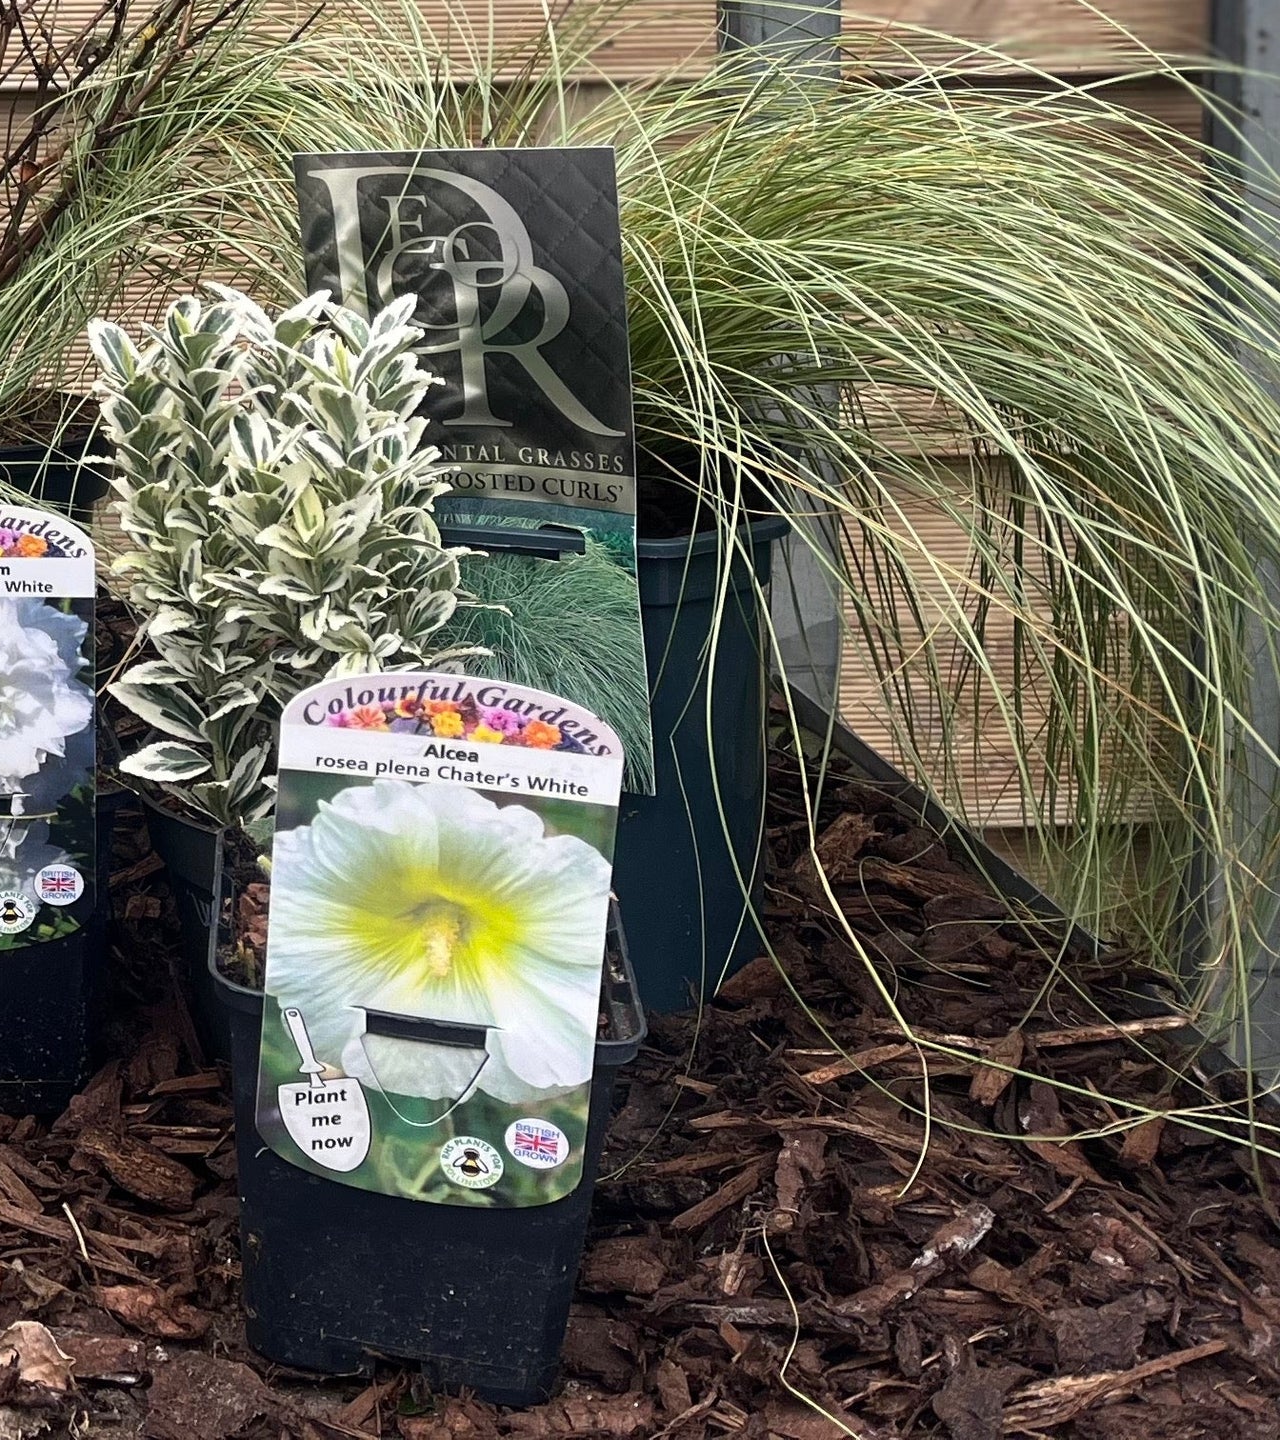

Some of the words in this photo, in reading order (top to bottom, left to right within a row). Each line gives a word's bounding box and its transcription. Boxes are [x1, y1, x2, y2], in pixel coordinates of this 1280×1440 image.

[518, 446, 624, 473] GRASSES
[438, 471, 536, 492] ROSTED
[542, 478, 624, 502] CURLS'
[4, 580, 53, 593] White
[303, 680, 466, 726] Colourful
[476, 686, 612, 757] Gardens
[423, 744, 479, 763] Alcea
[315, 755, 368, 771] rosea
[375, 759, 430, 778] plena
[437, 765, 520, 788] Chater's
[527, 776, 589, 797] White
[41, 870, 76, 878] BRITISH
[41, 891, 77, 899] GROWN
[295, 1089, 347, 1106] Plant
[311, 1113, 342, 1127] me
[515, 1123, 560, 1139] BRITISH
[311, 1135, 353, 1151] now
[454, 1137, 491, 1153] PLANTS
[513, 1148, 558, 1164] GROWN
